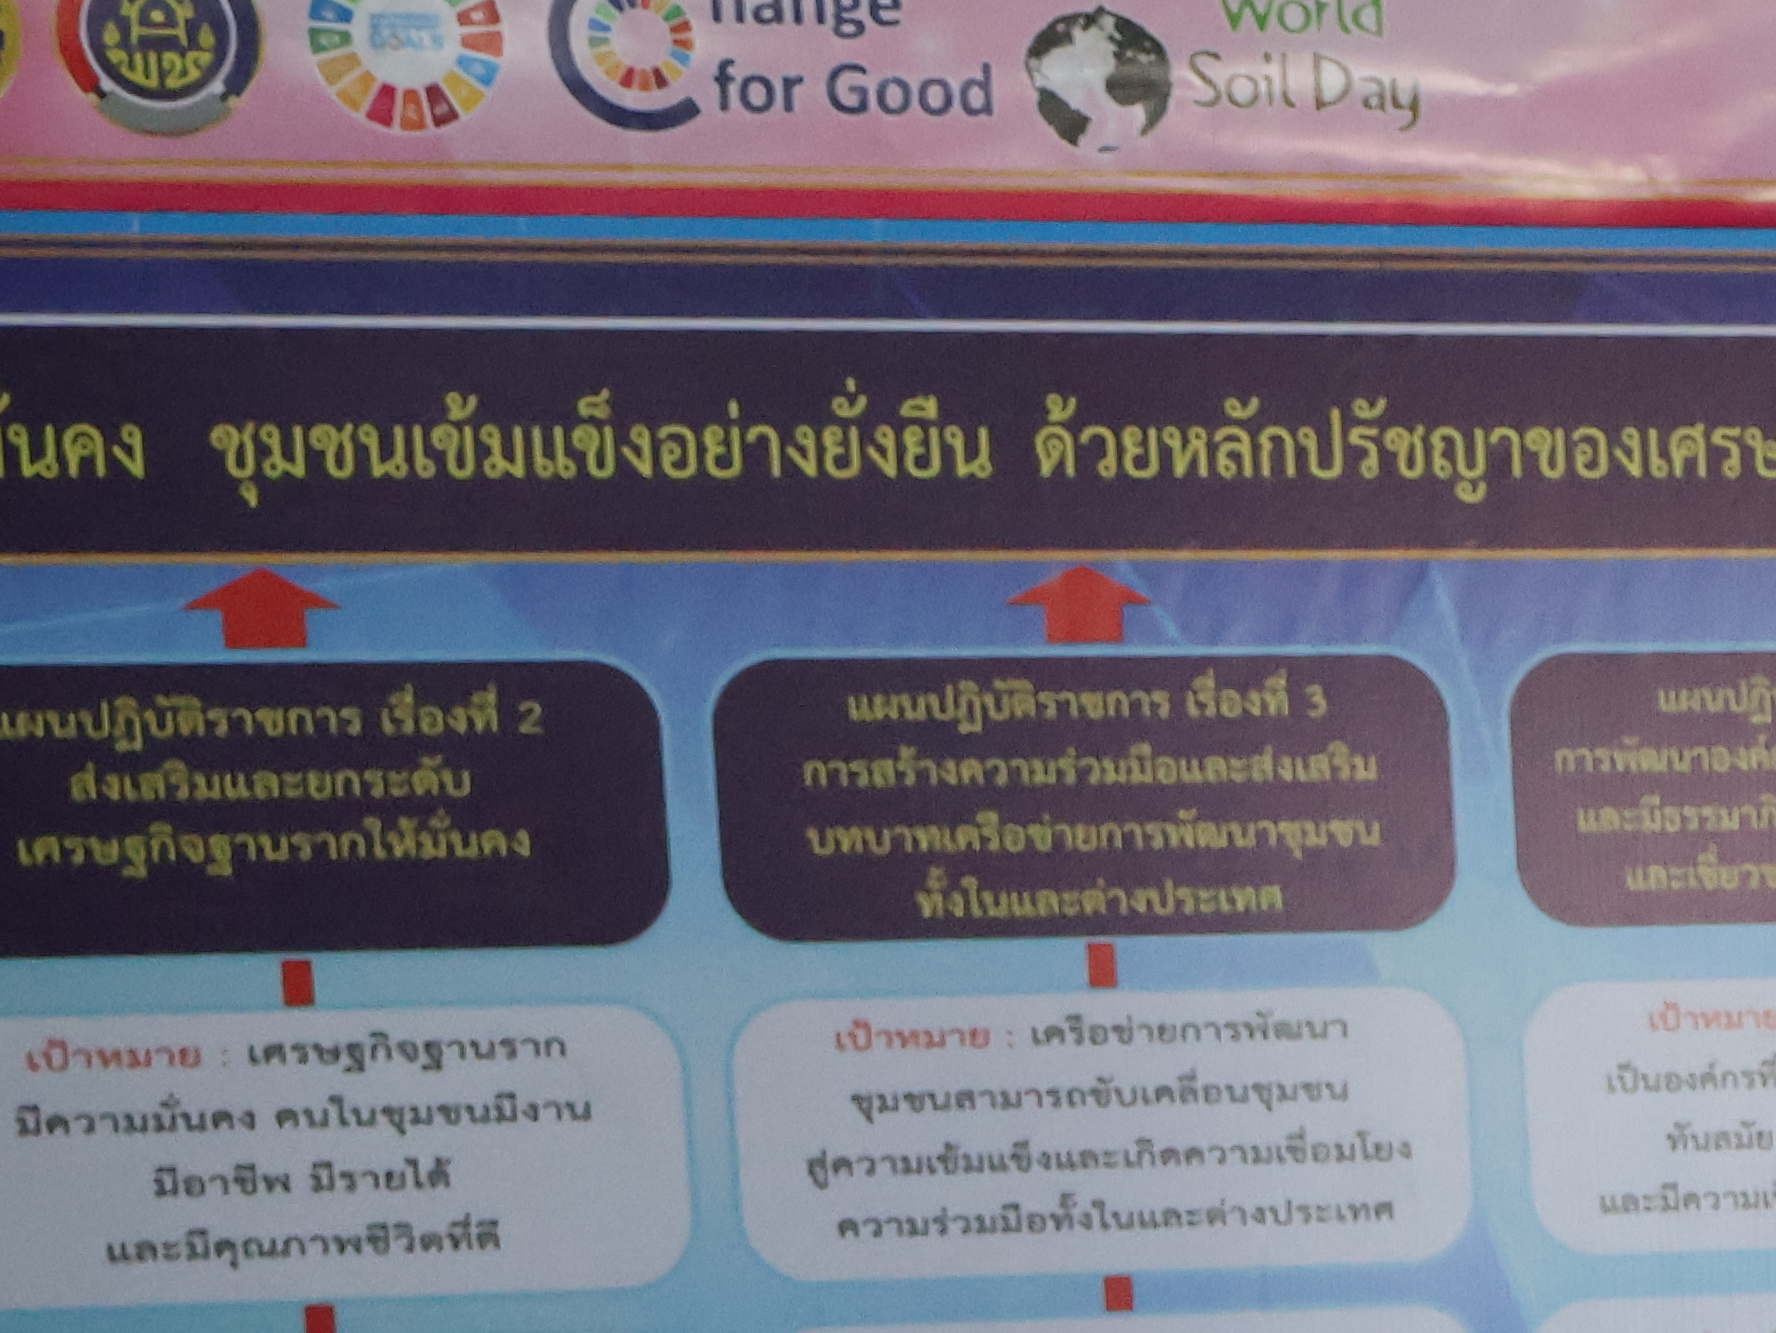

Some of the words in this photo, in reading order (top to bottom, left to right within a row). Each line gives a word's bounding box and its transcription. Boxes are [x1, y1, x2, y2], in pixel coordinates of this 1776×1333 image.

[714, 58, 803, 114] for
[827, 62, 993, 117] Good
[1188, 50, 1292, 112] Soil
[1312, 53, 1421, 132] Day
[0, 391, 147, 480] นคง
[208, 378, 993, 508] ชุมชนเข้มแข็งอย่างยั่งยืน
[518, 700, 545, 734] 2
[848, 678, 1171, 734] แผนปฏิบัติราชการ
[1185, 668, 1289, 718] เรื่องที่
[1306, 685, 1329, 717] 3
[69, 757, 471, 801] ส่งเสริมและยกระดับ
[804, 741, 1379, 788] การสร้างความร่วมมือและส่งเสริม
[17, 810, 531, 878] เศรษฐกิจฐานรากให้มั่นคง
[915, 867, 1284, 919] ทั้งในและต่างประเทศ
[26, 1036, 201, 1073] เป้าหมาย
[246, 1031, 568, 1073] เศรษฐกิจฐานราก
[834, 1018, 991, 1053] เป้าหมาย
[1030, 1008, 1349, 1049] เครือข่ายการพัฒนา
[12, 1091, 258, 1137] มีความมั่นคง
[275, 1090, 593, 1136] คนในชุมชนมีงาน
[850, 1068, 1349, 1125] ชุมชนสามารถขับเคลื่อนชุมชน
[1667, 1121, 1775, 1154] ทันสมัย
[153, 1162, 292, 1198] มีอาชีพ
[309, 1156, 452, 1194] มีรายได้
[105, 1211, 502, 1269] และมีคุณภาพชีวิตที่ดี
[837, 1193, 1396, 1240] ความร่วมมือทั้งในและต่างประเทศ
